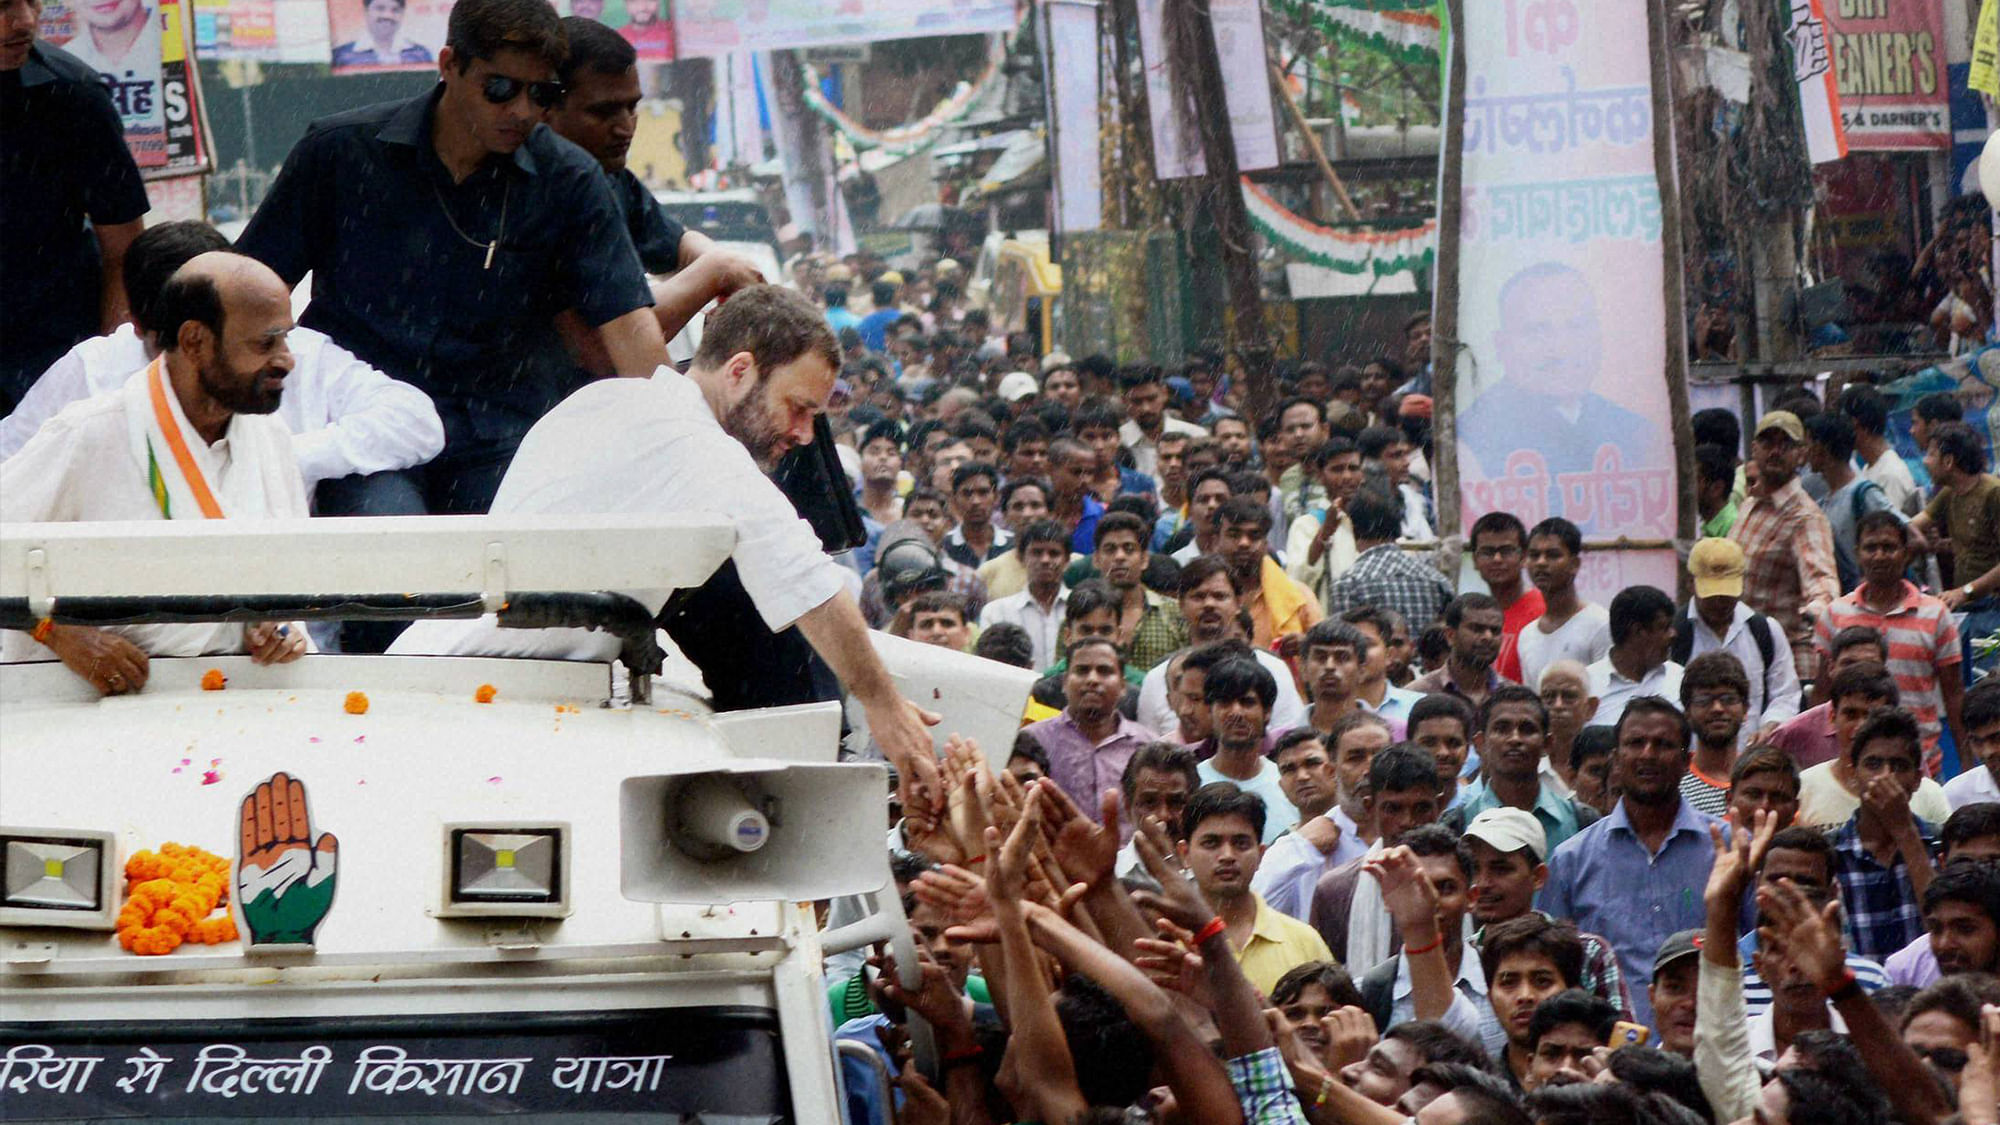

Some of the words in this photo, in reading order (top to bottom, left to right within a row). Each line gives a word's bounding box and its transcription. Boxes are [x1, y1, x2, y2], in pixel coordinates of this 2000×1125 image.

[1871, 111, 1940, 126] DARNER'S
[116, 1046, 174, 1094] से
[186, 1044, 334, 1098] दिल्ली
[348, 1045, 533, 1096] किसान
[552, 1055, 672, 1093] यात्रा
